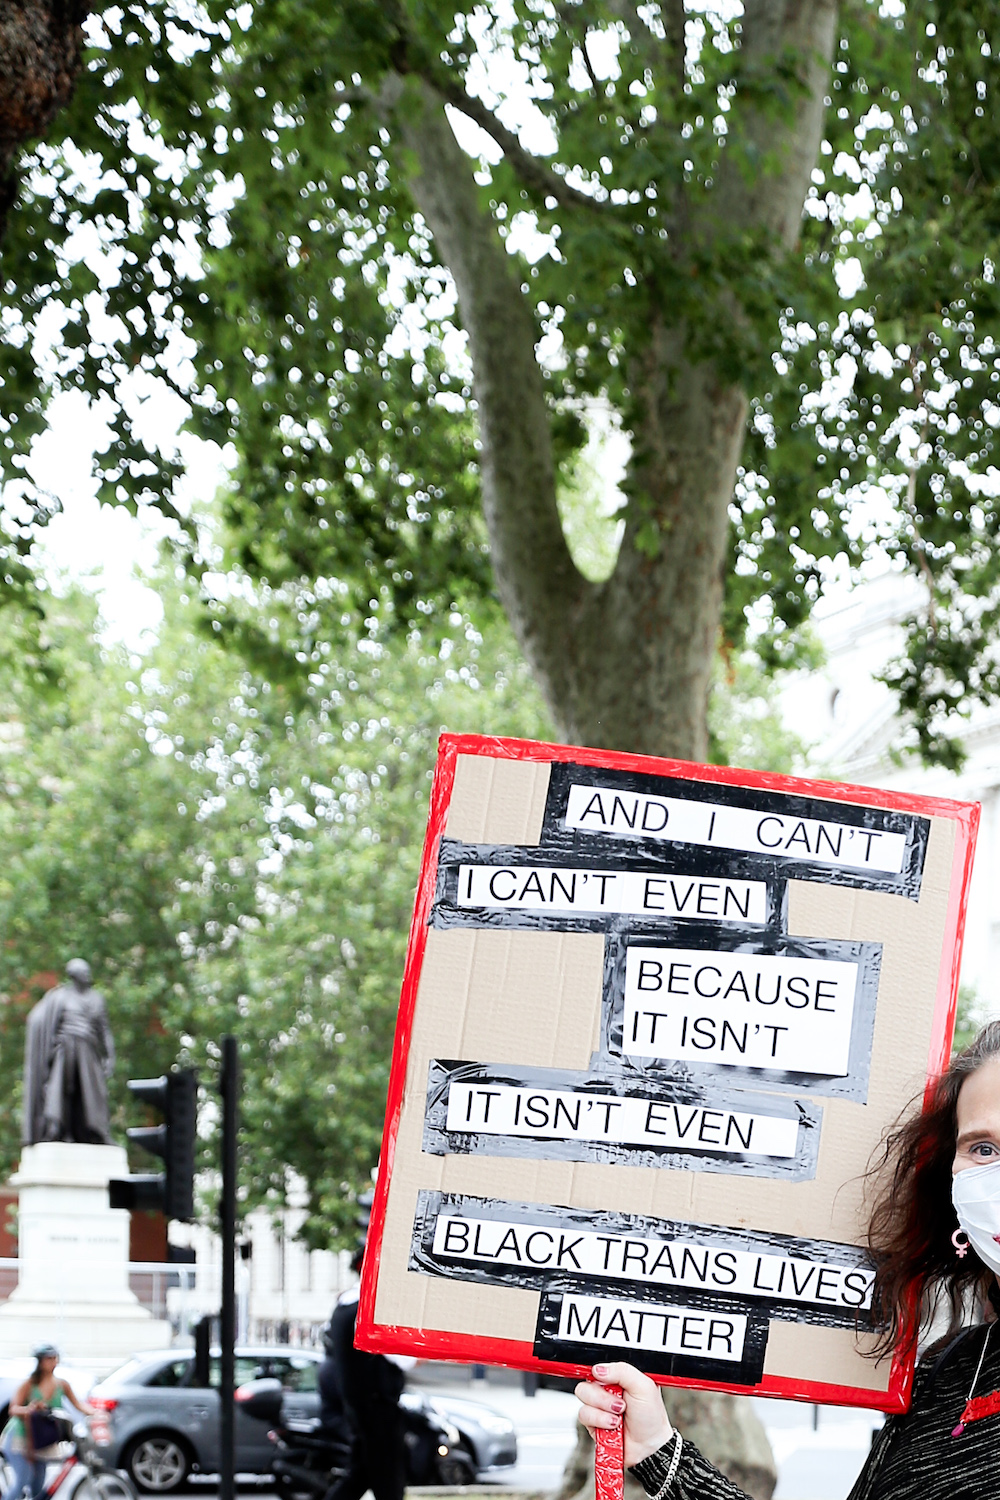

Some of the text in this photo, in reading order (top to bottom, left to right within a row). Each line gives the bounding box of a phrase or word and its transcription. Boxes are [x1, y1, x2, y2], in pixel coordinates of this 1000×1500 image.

[580, 793, 882, 862] AND I CAN'T
[466, 869, 751, 918] I CAN'T EVEN
[636, 960, 838, 1013] BECAUSE
[632, 1011, 790, 1057] IT ISN'T
[466, 1090, 754, 1150] IT ISN'T EVEN
[443, 1220, 867, 1306] BLACK TRANS LIVES
[566, 1303, 735, 1354] MATTER
